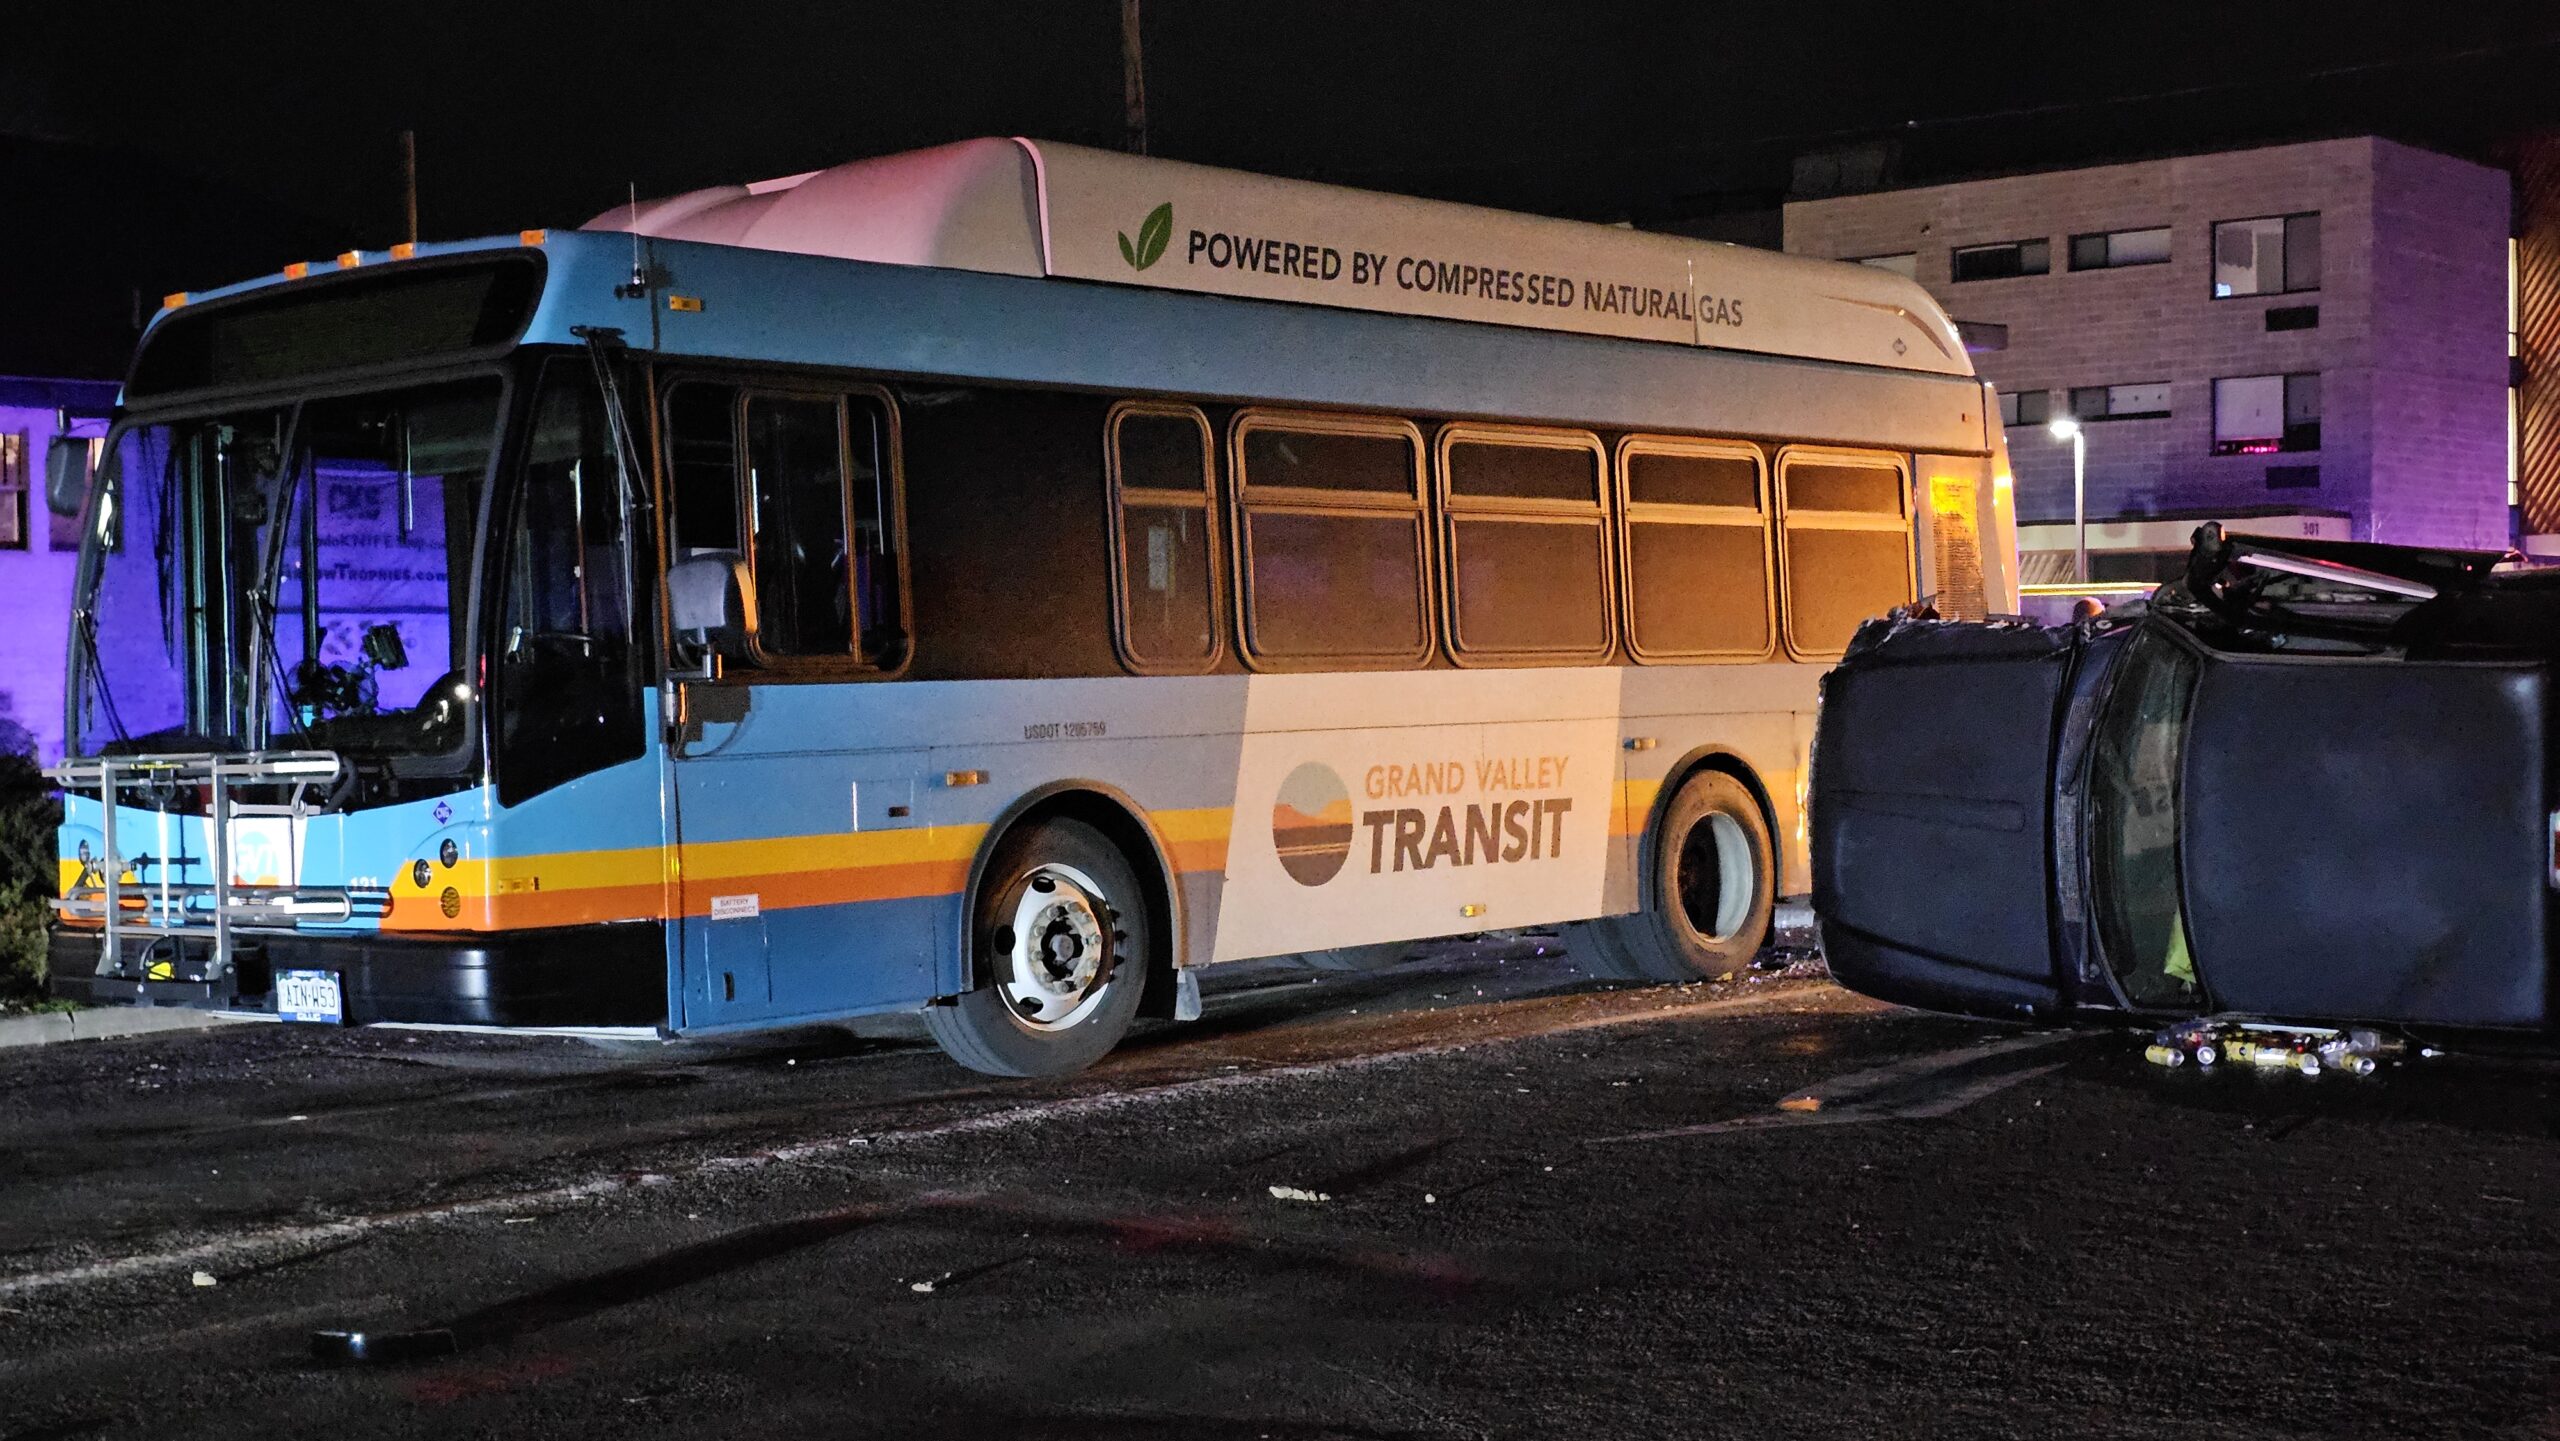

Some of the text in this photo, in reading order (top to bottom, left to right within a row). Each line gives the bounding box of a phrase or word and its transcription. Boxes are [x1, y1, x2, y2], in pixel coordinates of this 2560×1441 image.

[1188, 229, 1744, 328] POWERED BY COMPRESSED NATURAL GAS
[2303, 522, 2319, 537] 301
[1023, 722, 1060, 739] USDOT
[1365, 756, 1573, 799] GRAND VALLEY
[1362, 797, 1574, 875] TRANSIT
